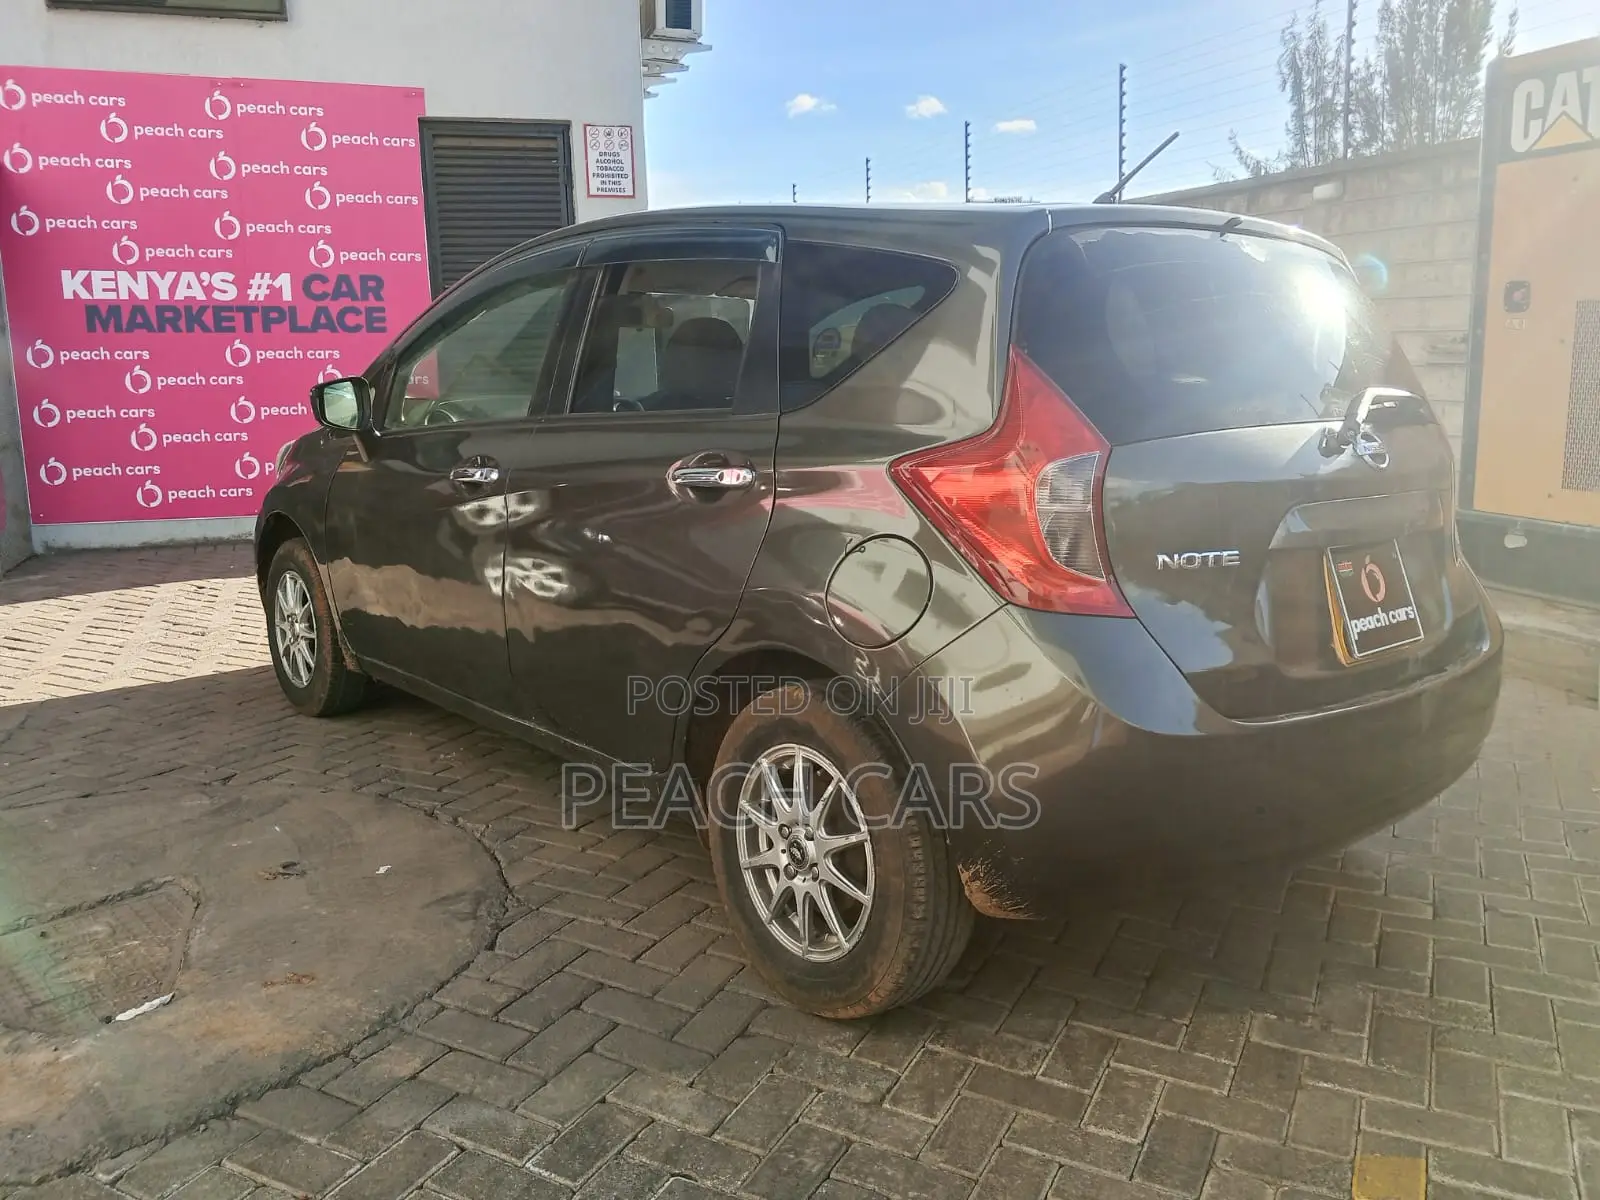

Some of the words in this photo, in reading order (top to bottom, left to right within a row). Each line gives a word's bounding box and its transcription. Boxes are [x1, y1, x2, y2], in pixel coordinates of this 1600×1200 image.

[31, 90, 85, 108] peach
[89, 94, 126, 107] cars
[237, 101, 285, 117] peach
[289, 105, 324, 117] cars
[134, 123, 184, 140] peach
[188, 128, 224, 139] cars
[332, 132, 379, 148] peach
[383, 136, 416, 147] cars
[38, 153, 91, 170] peach
[95, 157, 132, 169] cars
[241, 161, 290, 177] peach
[294, 165, 328, 176] cars
[140, 184, 189, 201] peach
[193, 188, 228, 199] cars
[336, 191, 382, 206] peach
[386, 194, 419, 205] cars
[45, 215, 97, 232] peach
[101, 219, 138, 230] cars
[246, 220, 294, 236] peach
[298, 223, 332, 234] cars
[145, 244, 194, 261] peach
[198, 248, 233, 259] cars
[340, 248, 385, 264] peach
[389, 251, 422, 262] cars
[247, 271, 293, 302] #1
[302, 273, 385, 302] CAR
[85, 303, 387, 334] MARKETPLACE
[60, 347, 110, 365] peach
[114, 350, 150, 360] cars
[256, 346, 303, 363] peach
[307, 349, 341, 360] cars
[157, 372, 205, 390] peach
[209, 374, 244, 385] cars
[66, 405, 116, 423] peach
[120, 407, 156, 418] cars
[260, 403, 307, 419] peach
[162, 429, 210, 447] peach
[214, 431, 249, 442] cars
[72, 463, 122, 480] peach
[125, 464, 161, 476] cars
[168, 485, 215, 503] peach
[219, 486, 253, 497] cars
[1157, 550, 1241, 570] NOTE
[1351, 606, 1390, 640] peach
[1388, 605, 1415, 625] cars
